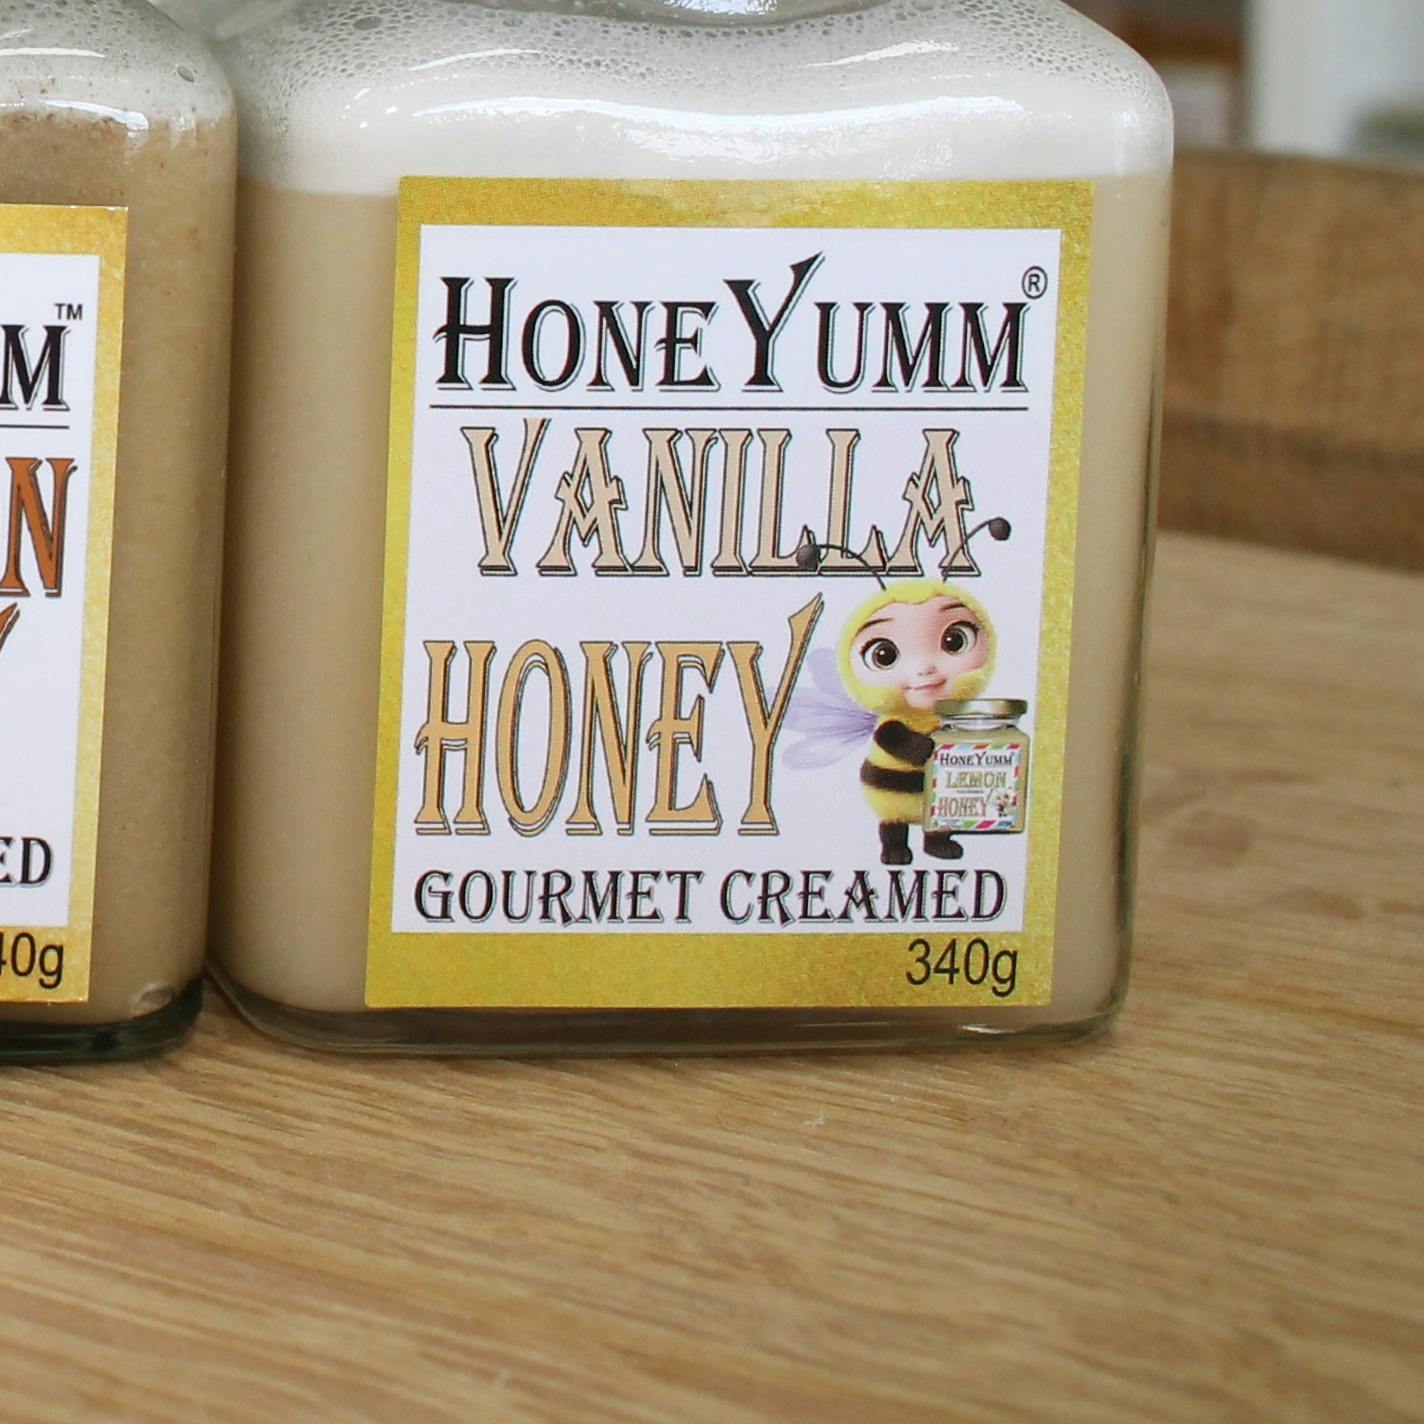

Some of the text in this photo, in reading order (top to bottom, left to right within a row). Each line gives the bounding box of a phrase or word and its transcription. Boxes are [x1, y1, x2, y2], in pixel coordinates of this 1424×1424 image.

[461, 418, 981, 577] VANILLA
[414, 592, 825, 837] HONEY
[945, 771, 1007, 789] LEMON
[414, 868, 1006, 928] GOURMET CREAMED
[906, 939, 1018, 996] 340g
